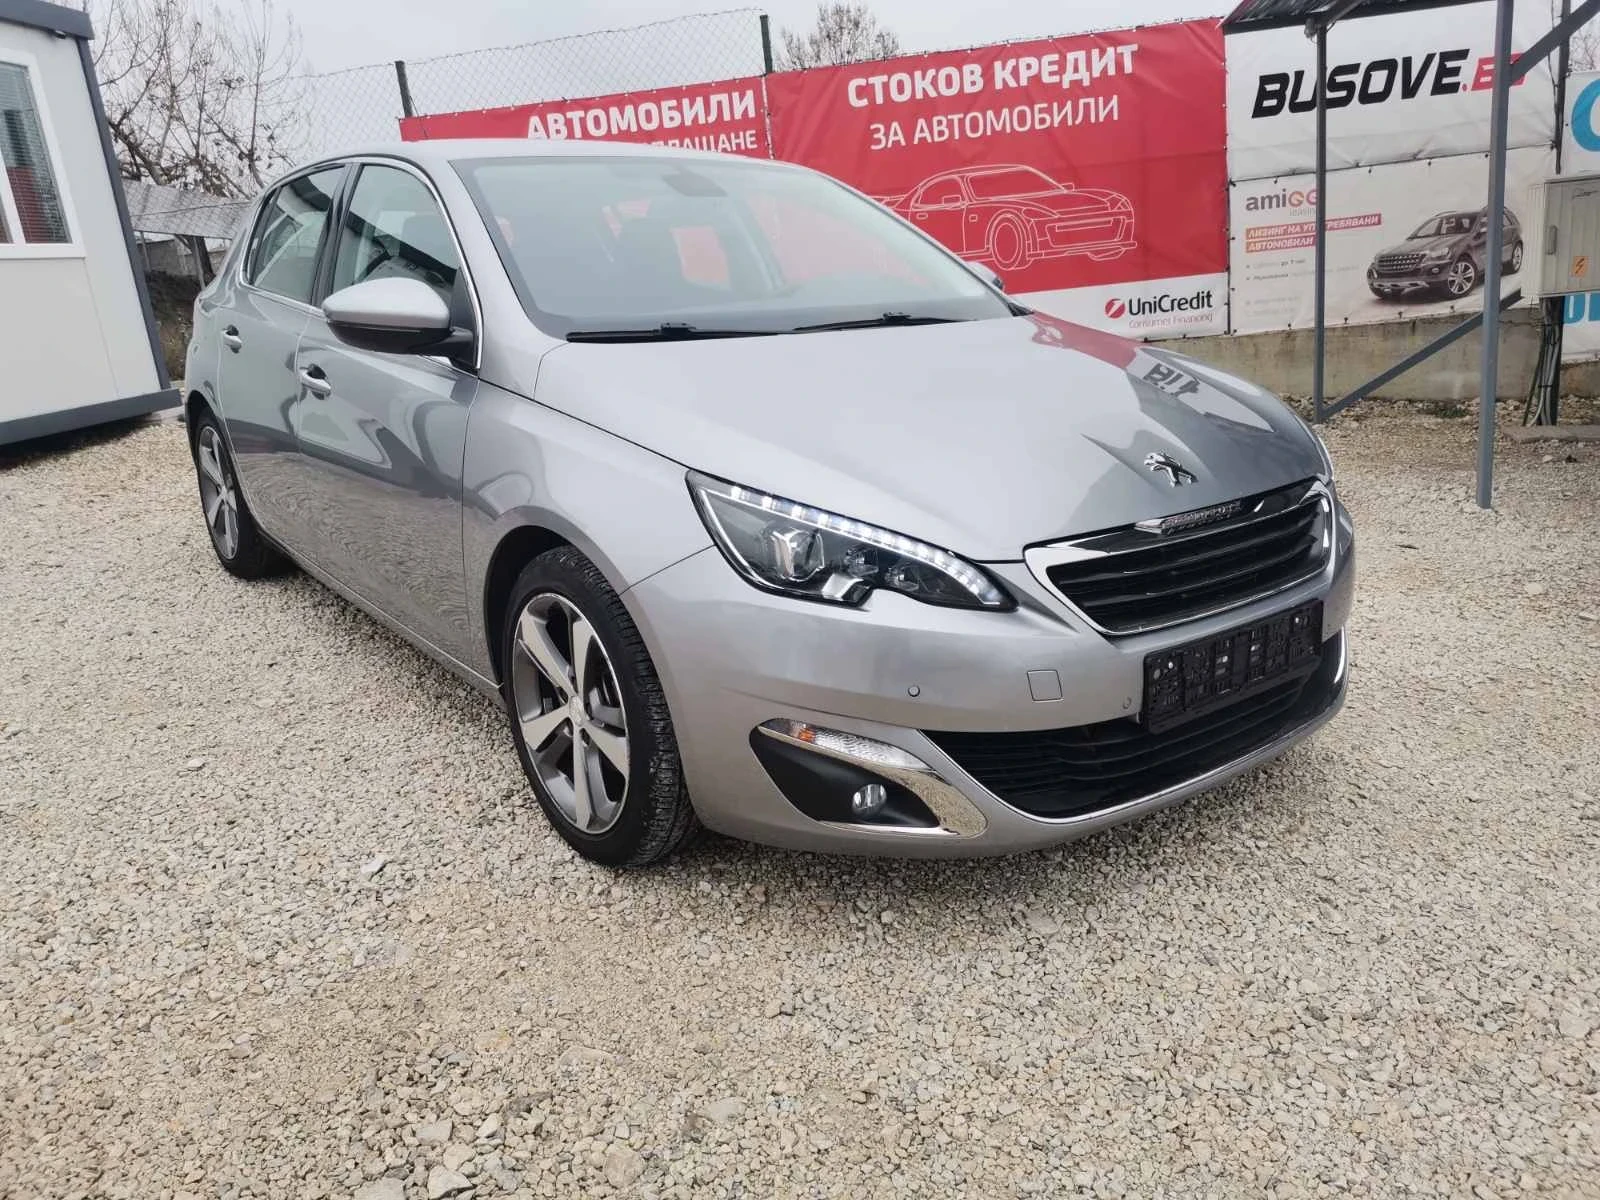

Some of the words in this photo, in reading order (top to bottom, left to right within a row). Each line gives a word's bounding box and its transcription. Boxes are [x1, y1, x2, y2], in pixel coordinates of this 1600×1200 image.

[848, 63, 983, 108] СТОКОВ
[994, 44, 1138, 90] КРЕДИТ
[528, 89, 756, 140] АВТОМОБИЛИ
[870, 122, 905, 150] ЗА
[914, 95, 1119, 144] АВТОМОБИЛИ
[1303, 215, 1379, 233] УПРЕБЯВАНИ
[1129, 290, 1213, 316] UniCredit
